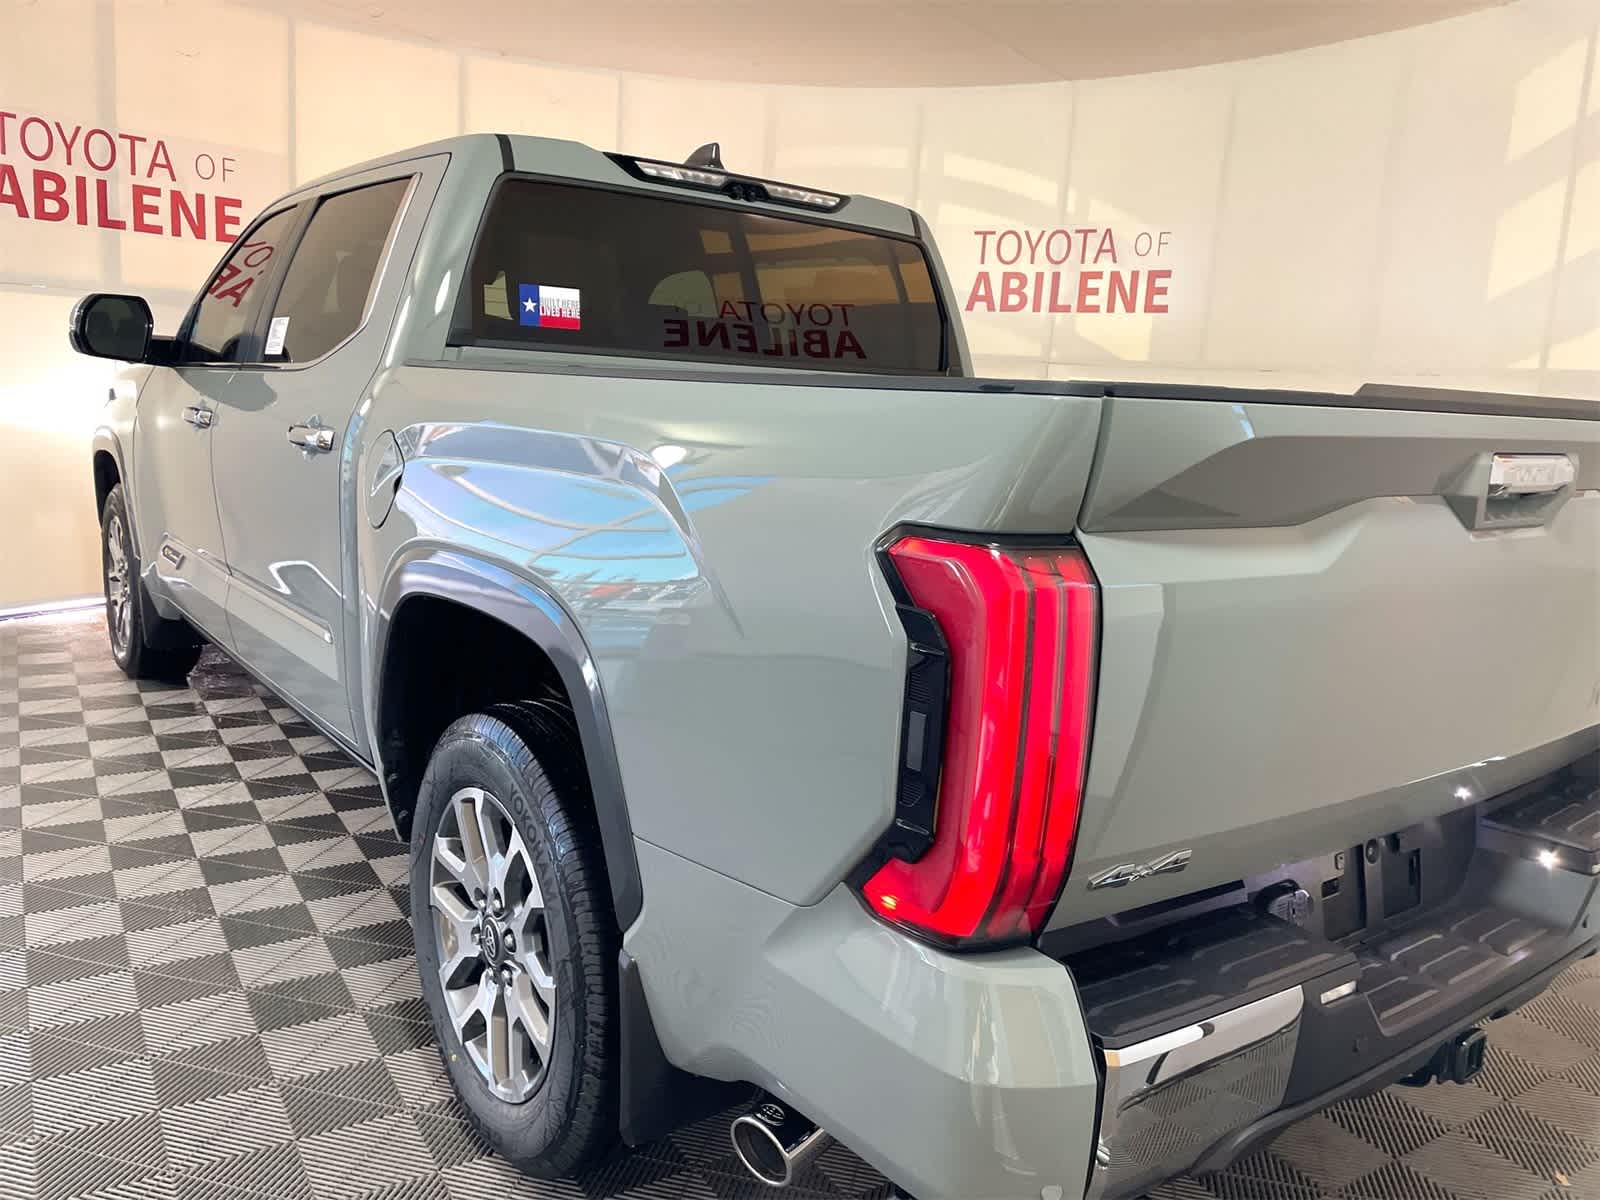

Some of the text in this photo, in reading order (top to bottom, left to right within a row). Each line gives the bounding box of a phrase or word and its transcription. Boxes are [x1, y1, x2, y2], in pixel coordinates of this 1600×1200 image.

[0, 111, 236, 183] TOYOTA OF
[0, 164, 242, 243] ABILENE
[974, 228, 1172, 265] TOYOTA OF
[965, 270, 1172, 313] ABILENE
[561, 308, 581, 319] HERE
